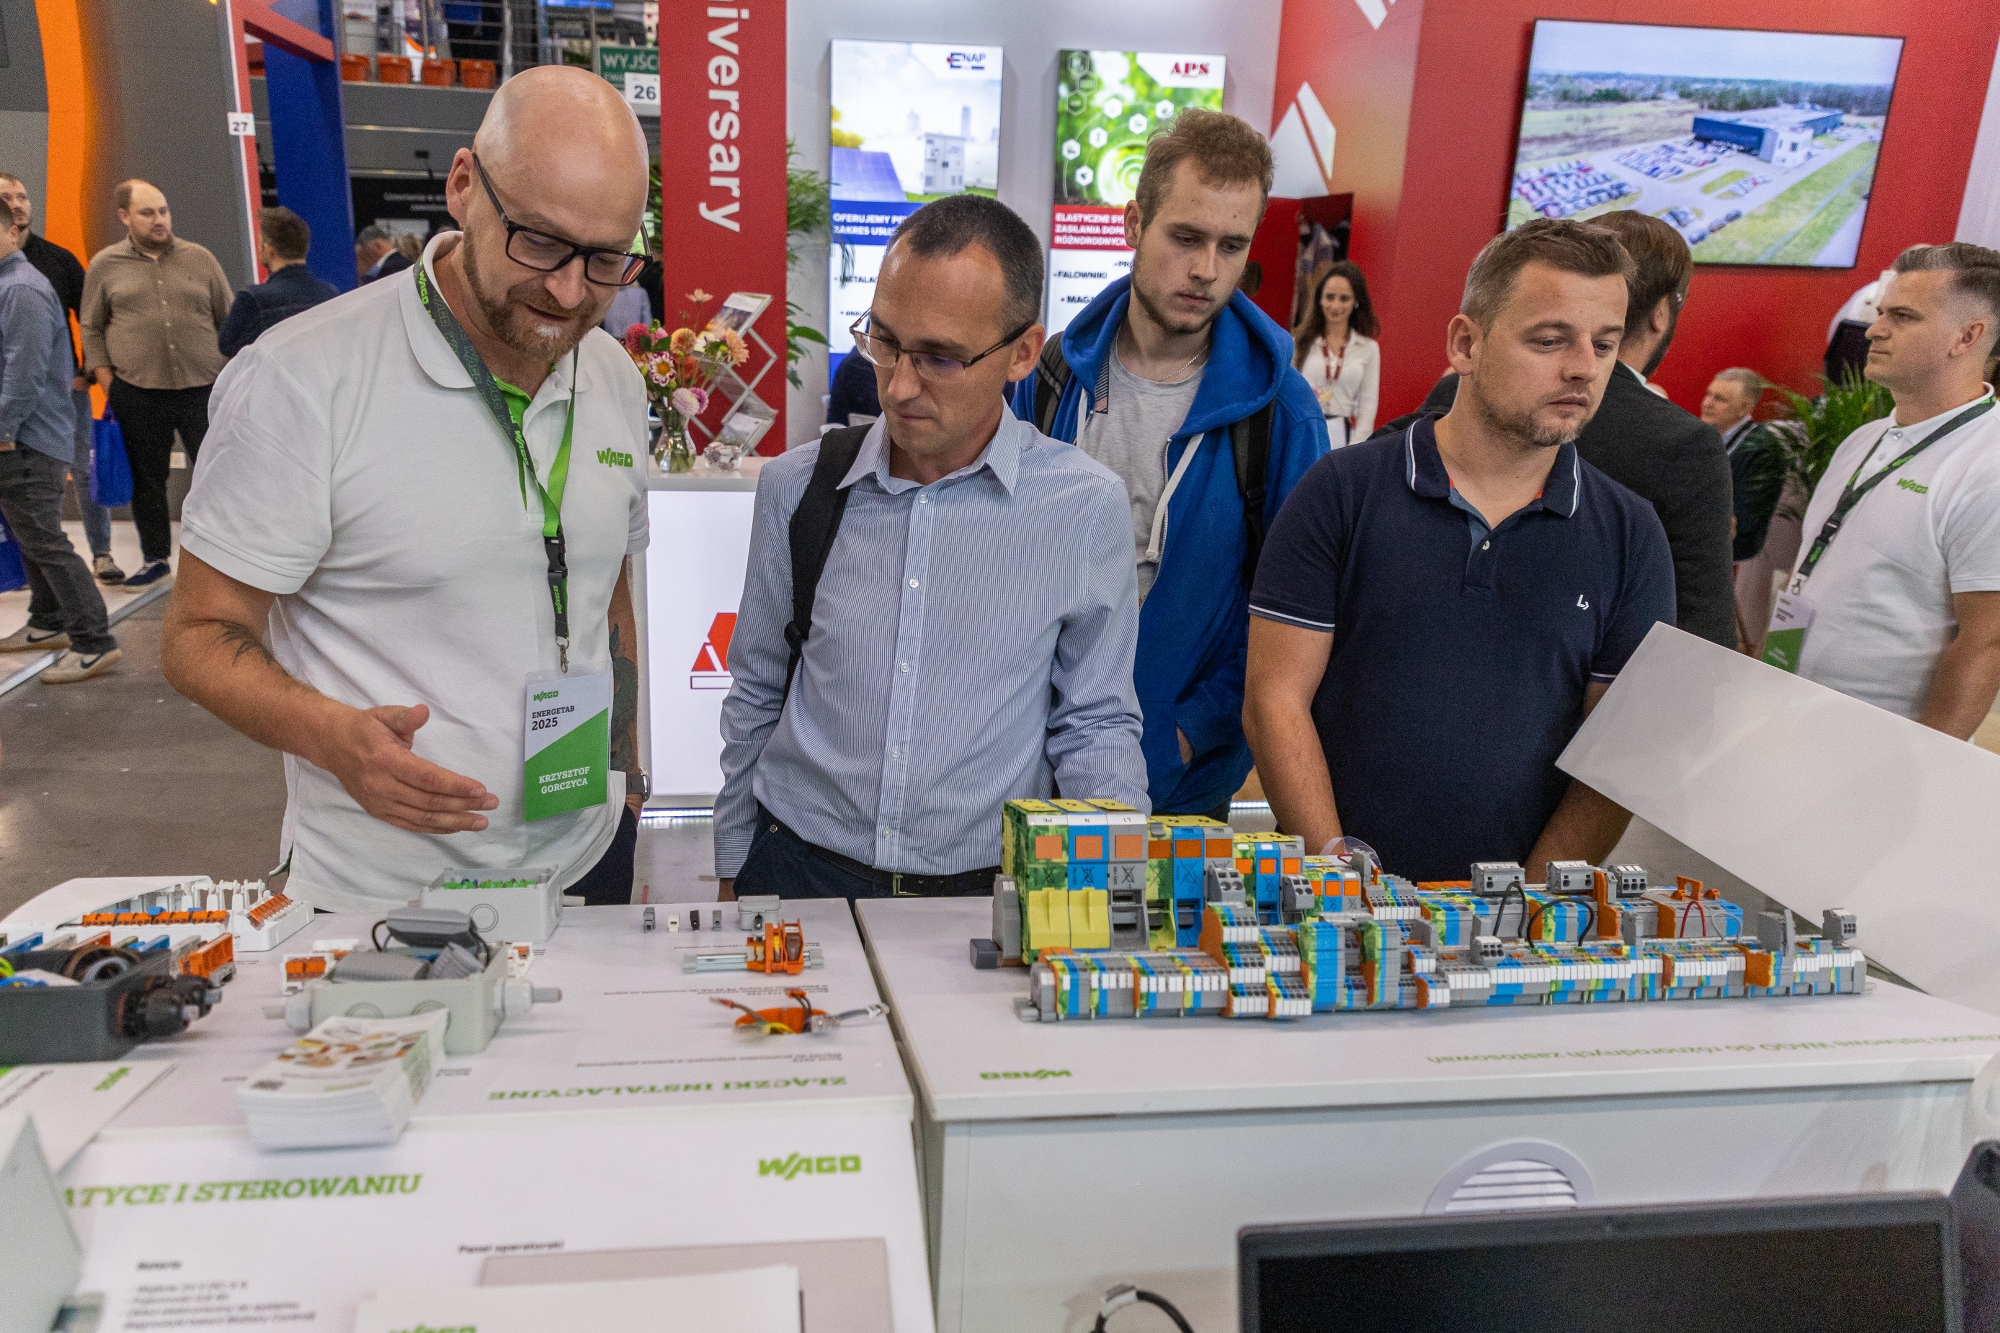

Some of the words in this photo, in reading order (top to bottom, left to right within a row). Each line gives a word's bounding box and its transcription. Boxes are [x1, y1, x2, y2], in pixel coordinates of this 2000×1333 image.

[601, 52, 658, 70] WYJŚC
[634, 85, 657, 100] 26
[699, 0, 750, 232] iversary
[232, 121, 248, 132] 27
[832, 212, 891, 224] OFERUJEMY
[891, 214, 907, 225] PE
[1055, 212, 1110, 224] ELASTYCZNE
[834, 225, 870, 235] ZAKRES
[1055, 223, 1101, 234] ZASILANIA
[1057, 271, 1108, 279] FALOWNIKI
[418, 270, 430, 305] WAGO
[595, 447, 634, 468] WAGO
[553, 585, 563, 615] WAGO
[533, 690, 559, 703] WAGO
[532, 705, 575, 719] ENERGETAB
[531, 716, 558, 731] 2025
[539, 766, 591, 785] KRZYSZTOF
[541, 777, 589, 794] GORCZYCA
[758, 1151, 862, 1181] WAGO
[173, 1183, 190, 1204] I
[193, 1173, 424, 1202] STEROWANIU
